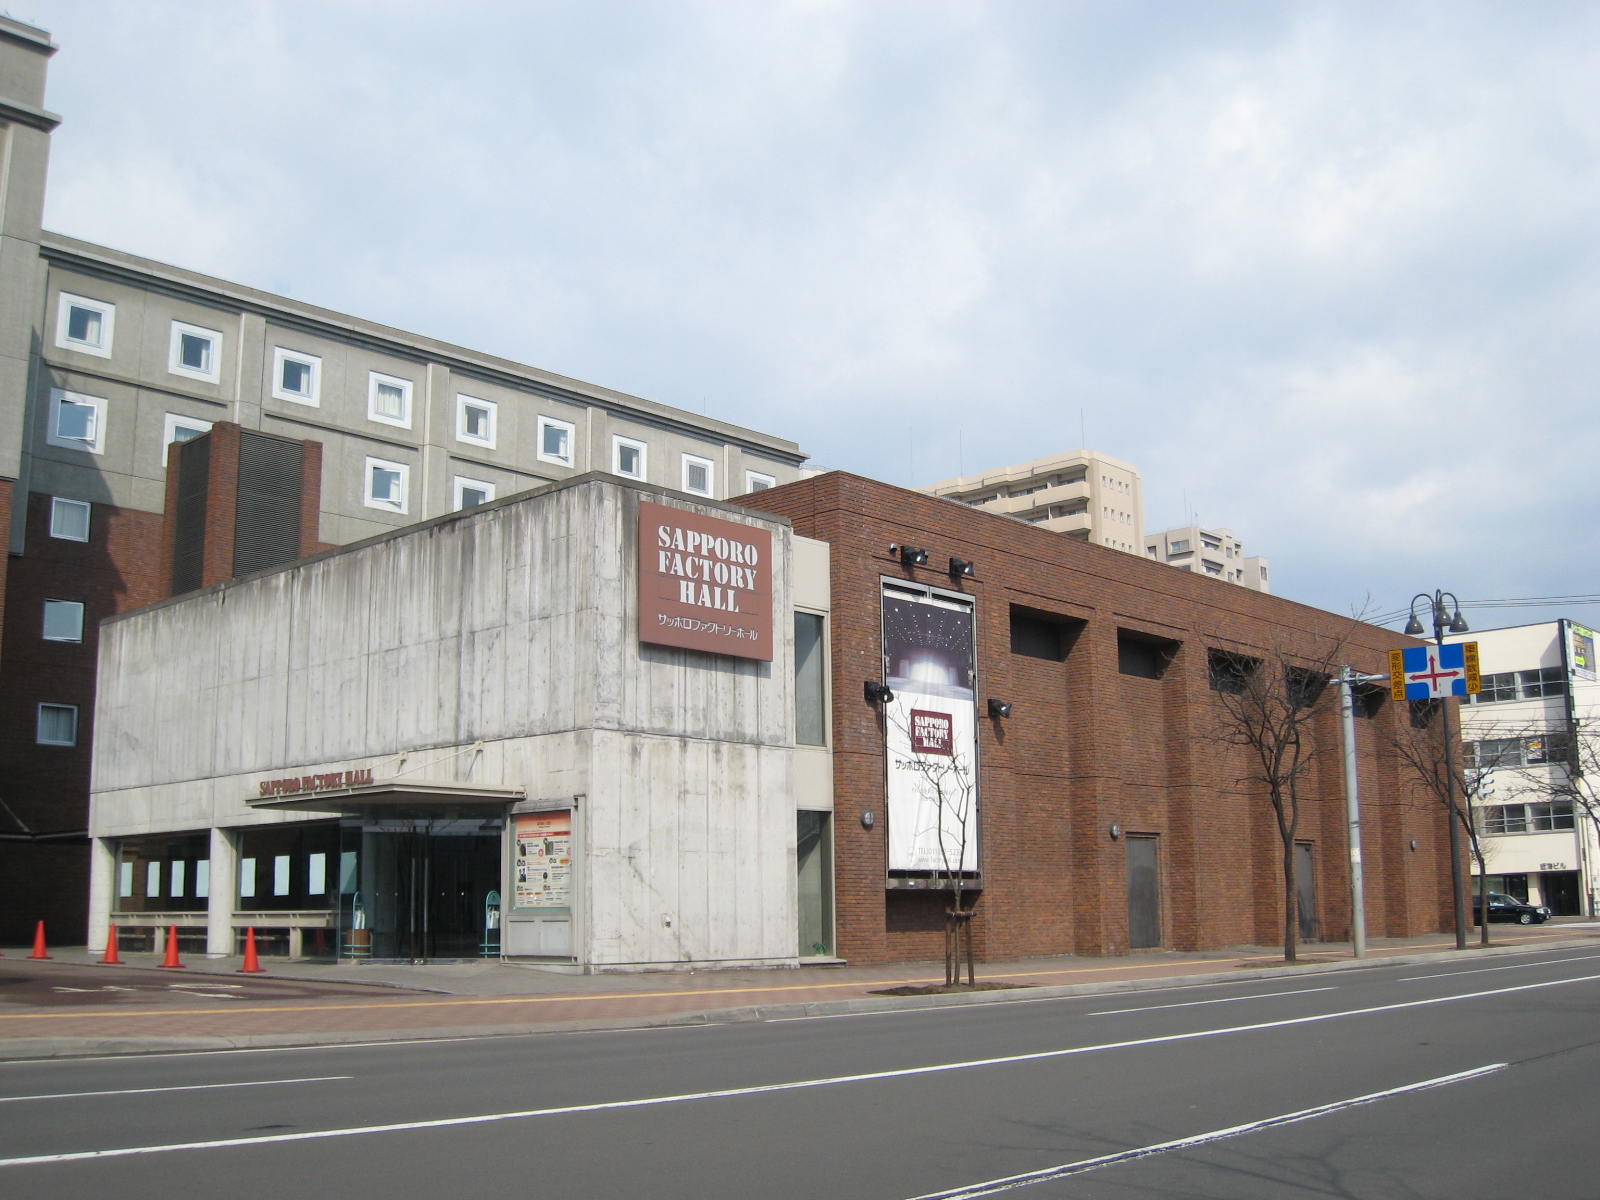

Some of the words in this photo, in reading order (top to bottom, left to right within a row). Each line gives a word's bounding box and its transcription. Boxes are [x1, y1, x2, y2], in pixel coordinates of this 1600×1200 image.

[658, 525, 758, 566] SAPPORO
[658, 550, 757, 591] FACTORY
[680, 580, 740, 613] HALL
[658, 613, 758, 641] サッポロファクトリーホール
[1391, 652, 1404, 698] 変形交差点
[1465, 644, 1479, 692] 車線数減少
[914, 715, 949, 730] SAPPORO
[915, 726, 949, 740] FACTORY
[259, 777, 301, 796] SAPPORO
[301, 771, 343, 792] FACTORY
[344, 768, 374, 788] HALL
